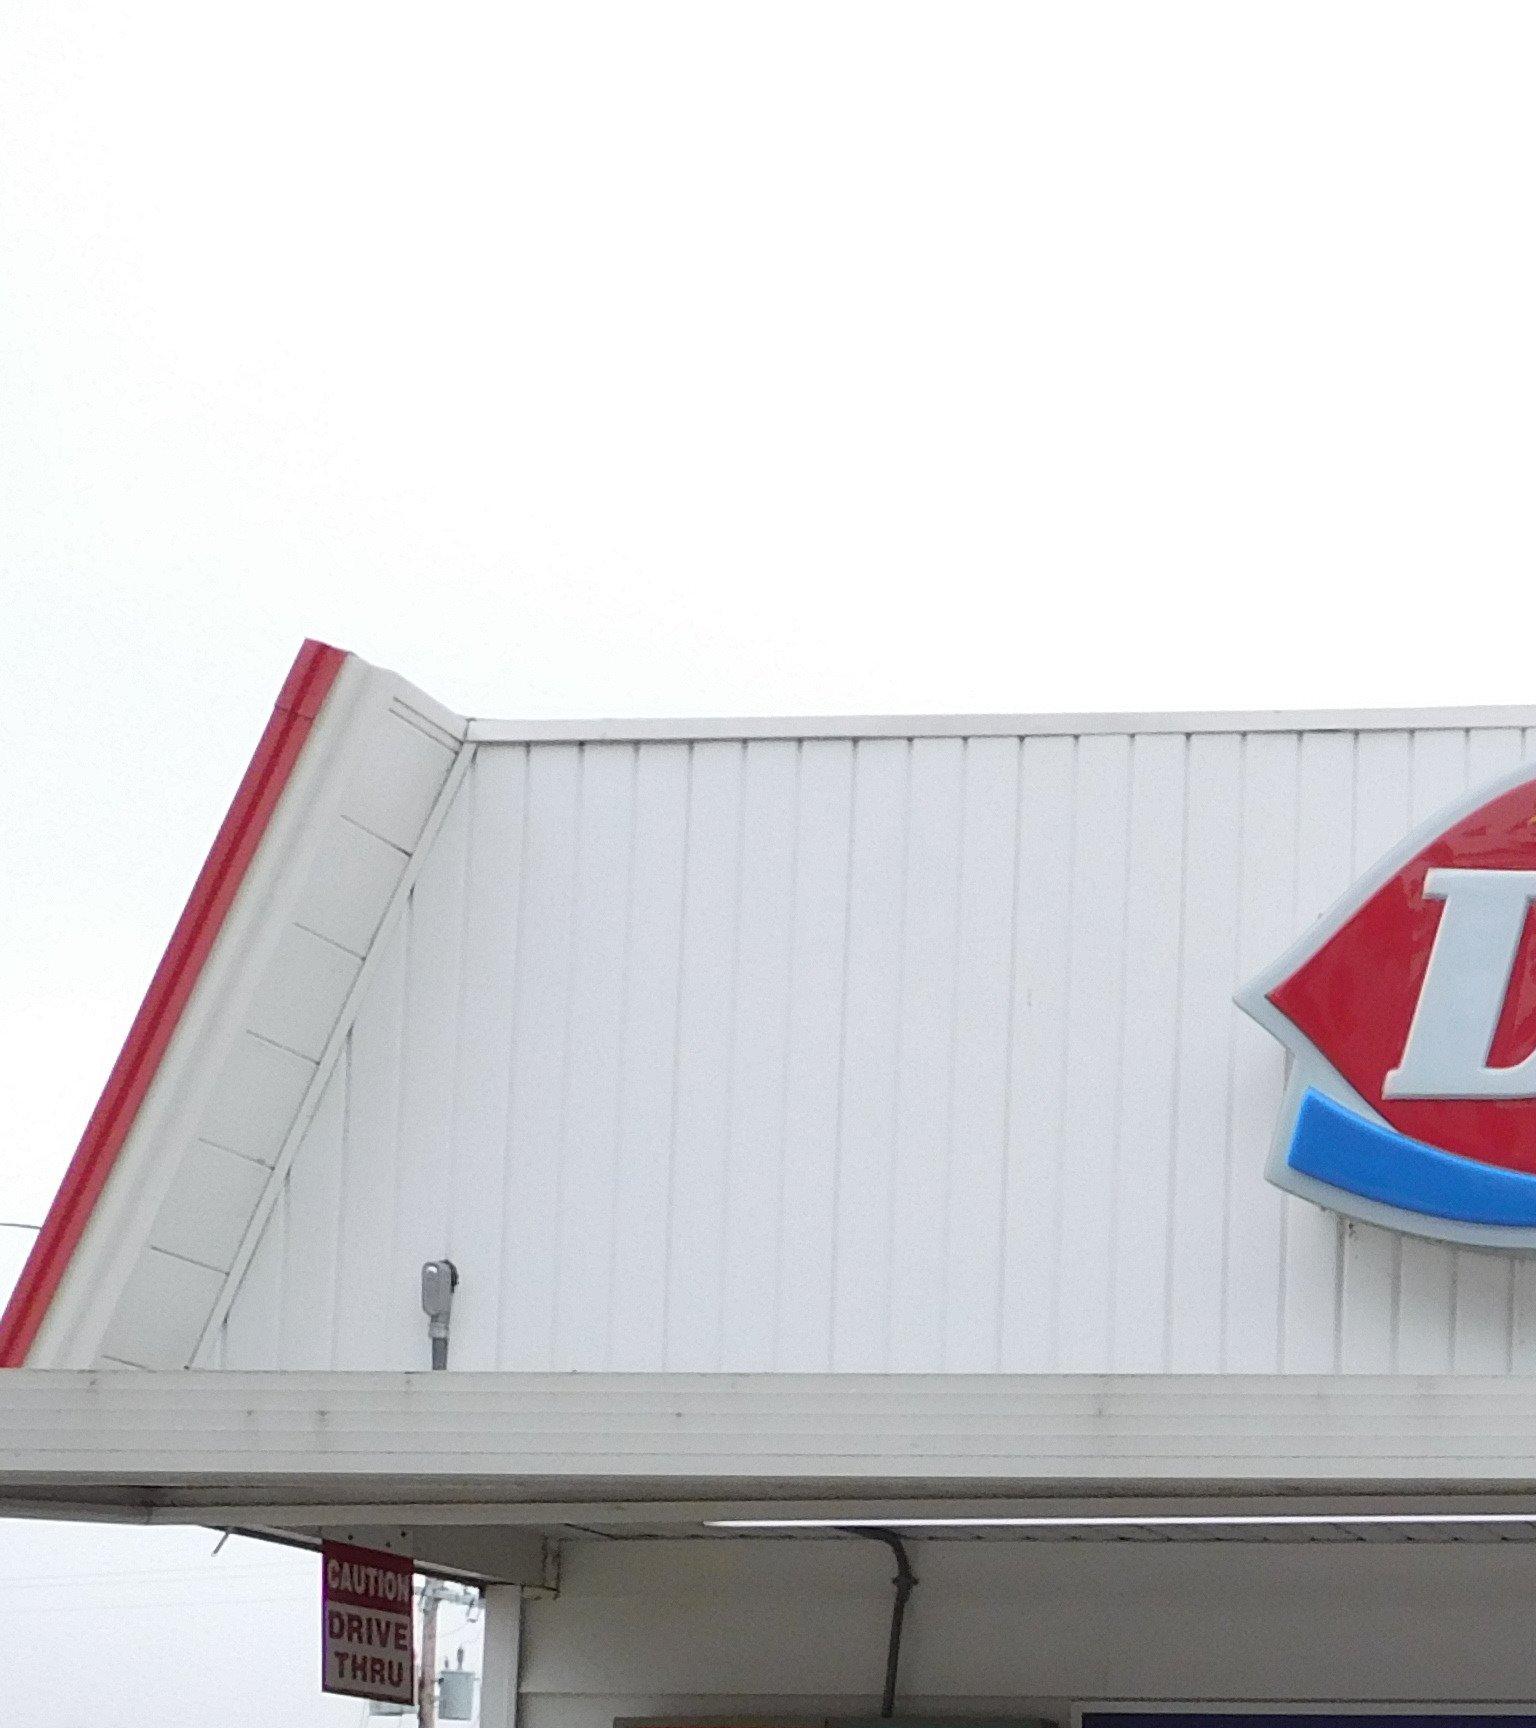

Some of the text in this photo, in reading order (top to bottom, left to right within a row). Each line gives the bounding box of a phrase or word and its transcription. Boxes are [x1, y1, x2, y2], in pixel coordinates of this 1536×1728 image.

[327, 1558, 413, 1601] CAUTION
[329, 1609, 408, 1651] DRIVE
[334, 1652, 404, 1688] THRU
